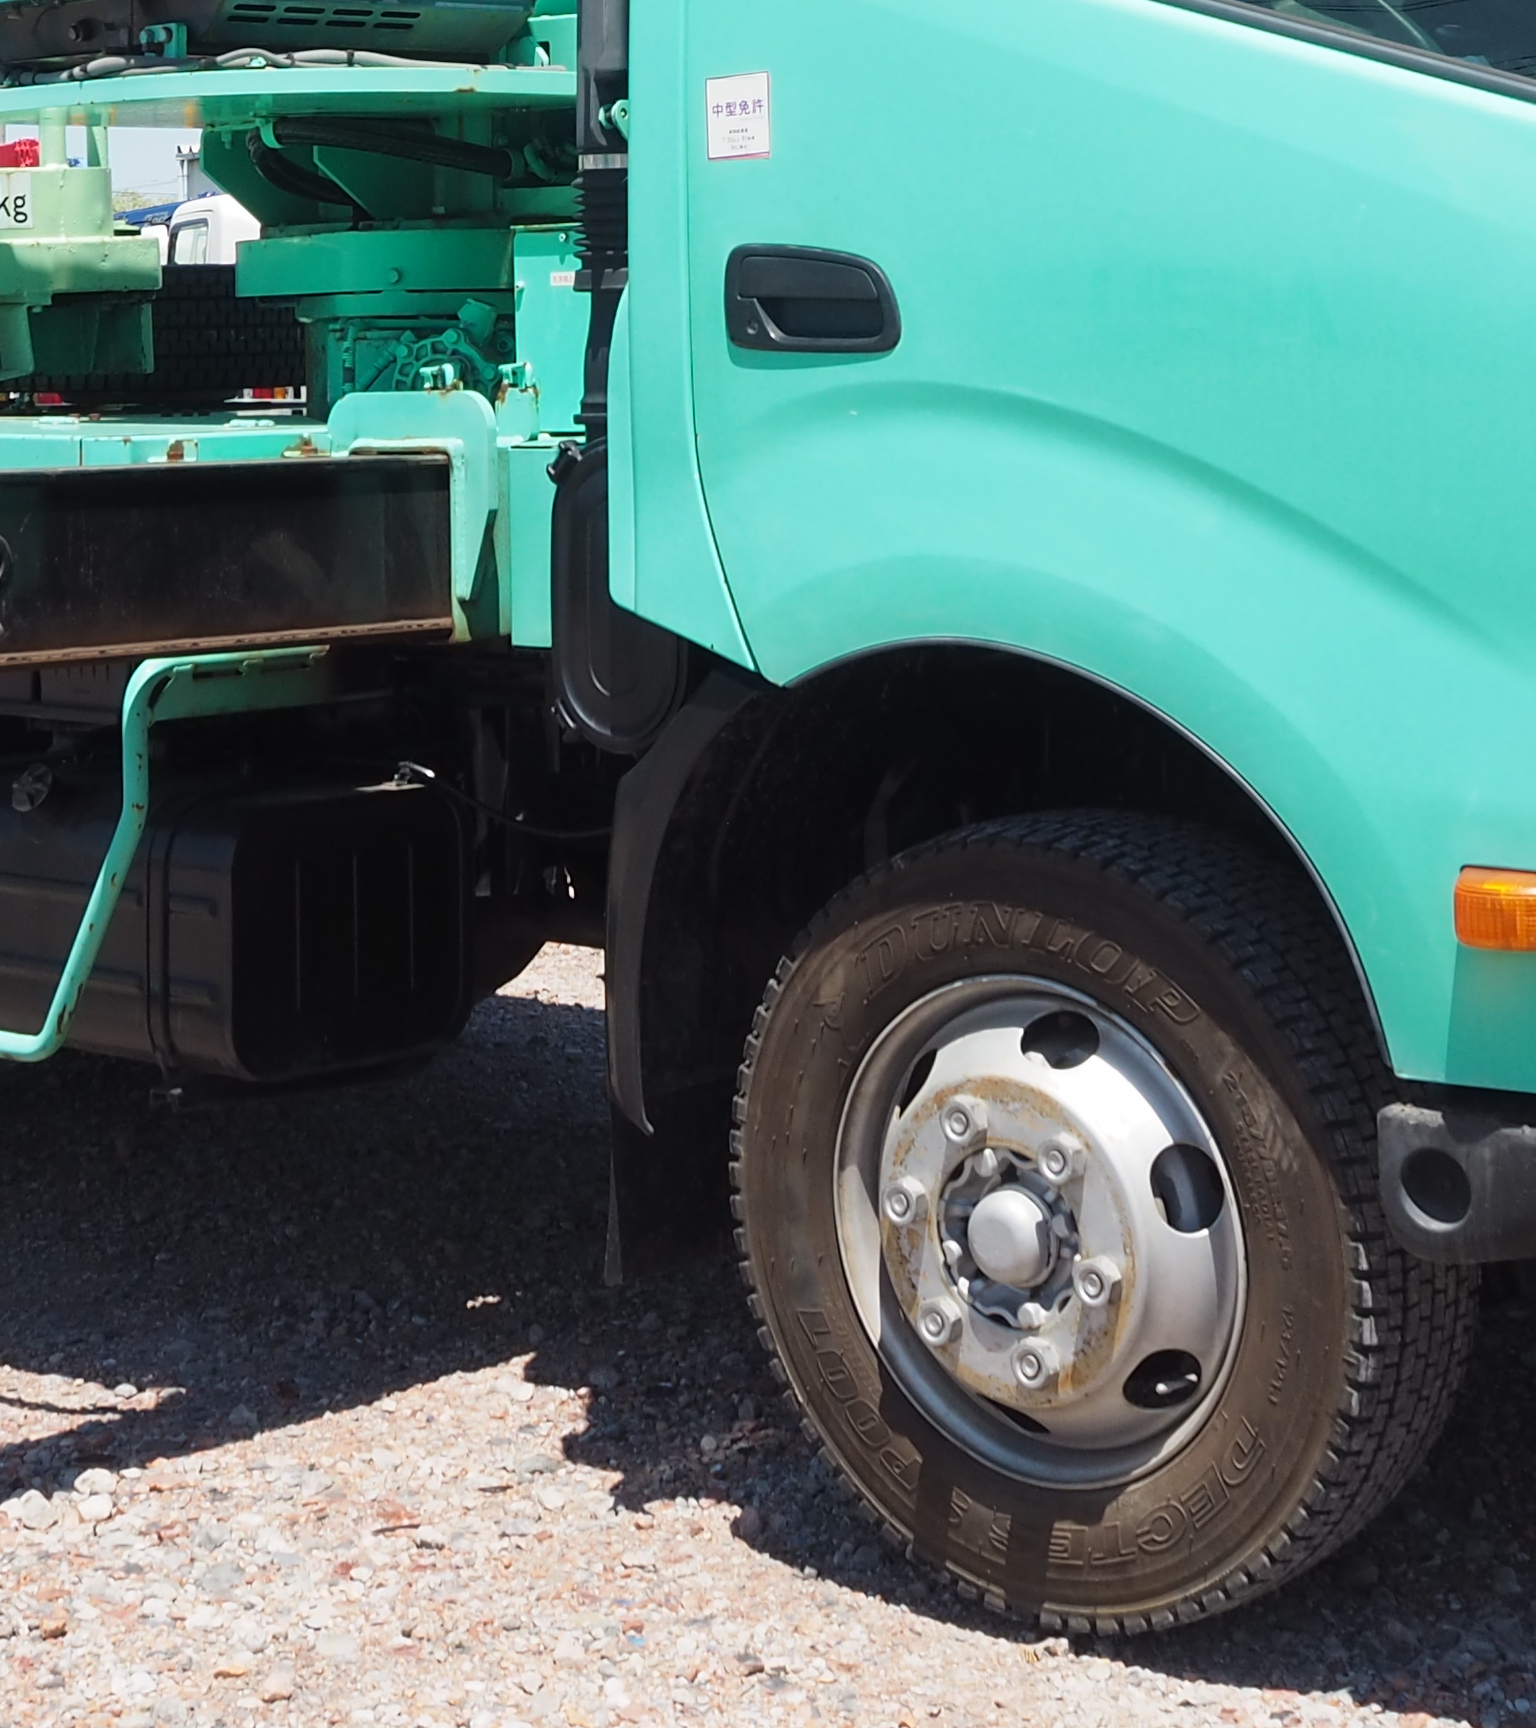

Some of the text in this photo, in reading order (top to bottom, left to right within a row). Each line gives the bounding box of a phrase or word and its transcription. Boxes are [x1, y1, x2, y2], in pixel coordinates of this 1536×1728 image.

[712, 98, 765, 119] 中型免許
[855, 901, 1201, 1023] DUNLOP
